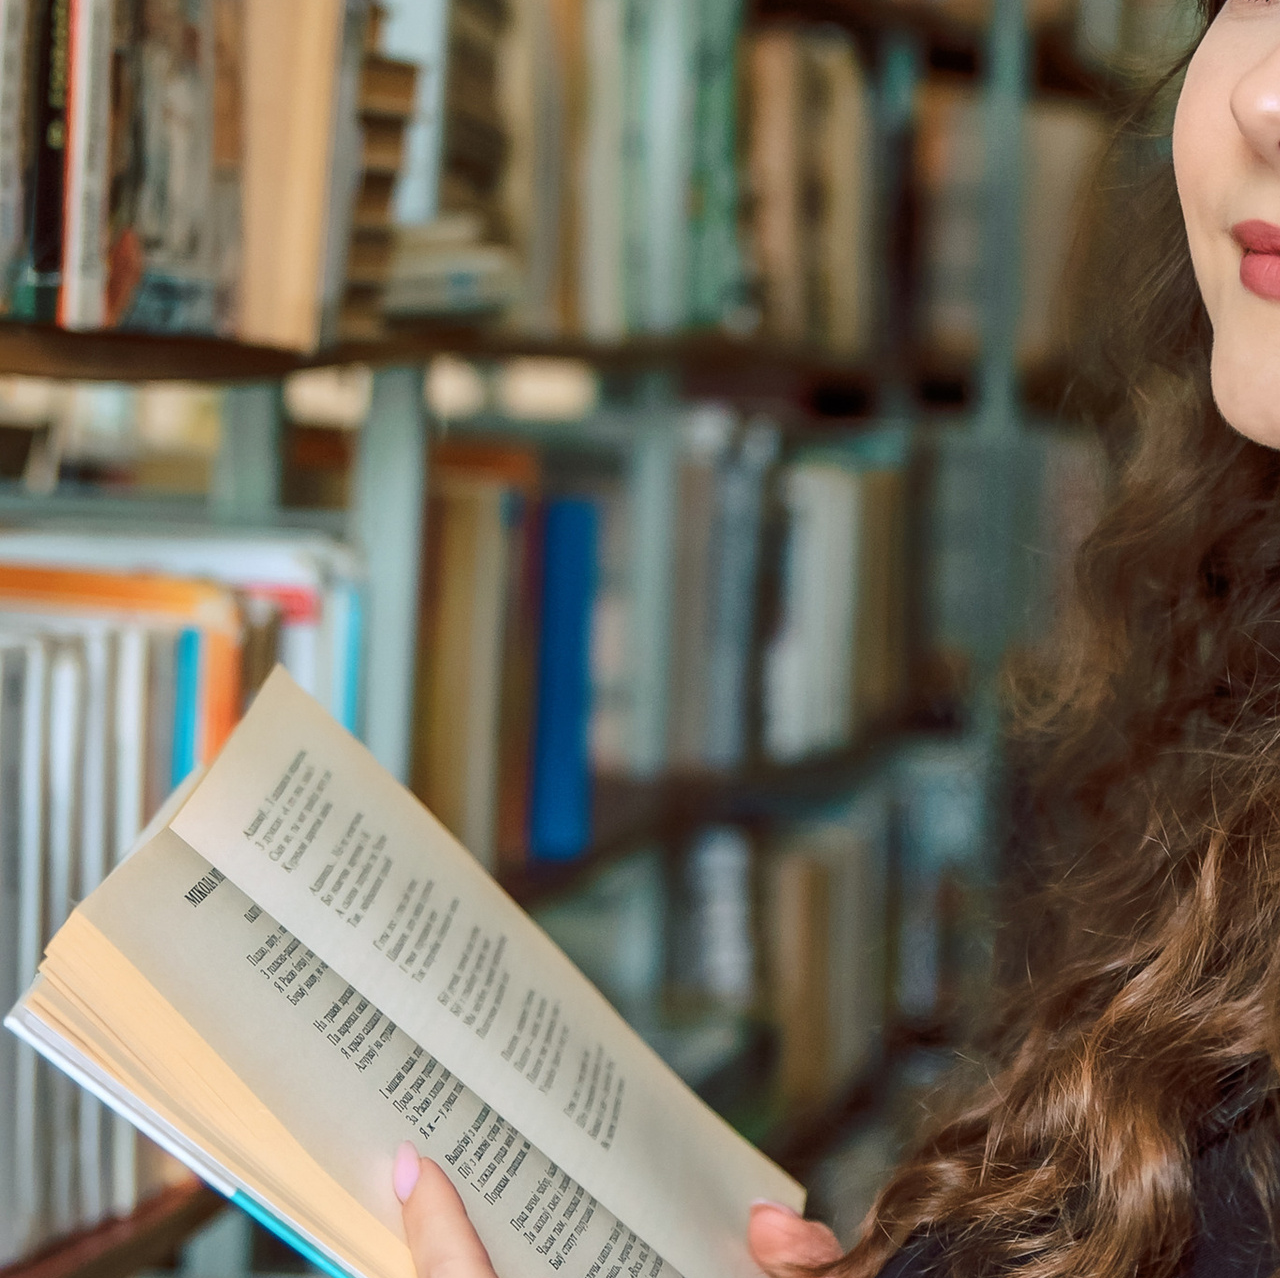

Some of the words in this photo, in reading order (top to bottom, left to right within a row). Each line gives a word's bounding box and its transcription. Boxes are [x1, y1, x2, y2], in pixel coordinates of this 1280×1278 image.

[184, 876, 218, 908] МІКОЛА
[273, 981, 285, 994] Я
[312, 1020, 328, 1033] На
[326, 1033, 341, 1046] Па
[340, 1047, 351, 1060] Я
[405, 1114, 419, 1126] За
[419, 1127, 430, 1140] Я
[457, 1161, 474, 1179] Піў
[509, 1211, 529, 1232] Прад
[523, 1231, 537, 1245] Ля
[535, 1234, 557, 1255] Часам
[552, 1220, 568, 1236] тым,
[548, 1251, 566, 1271] Быў
